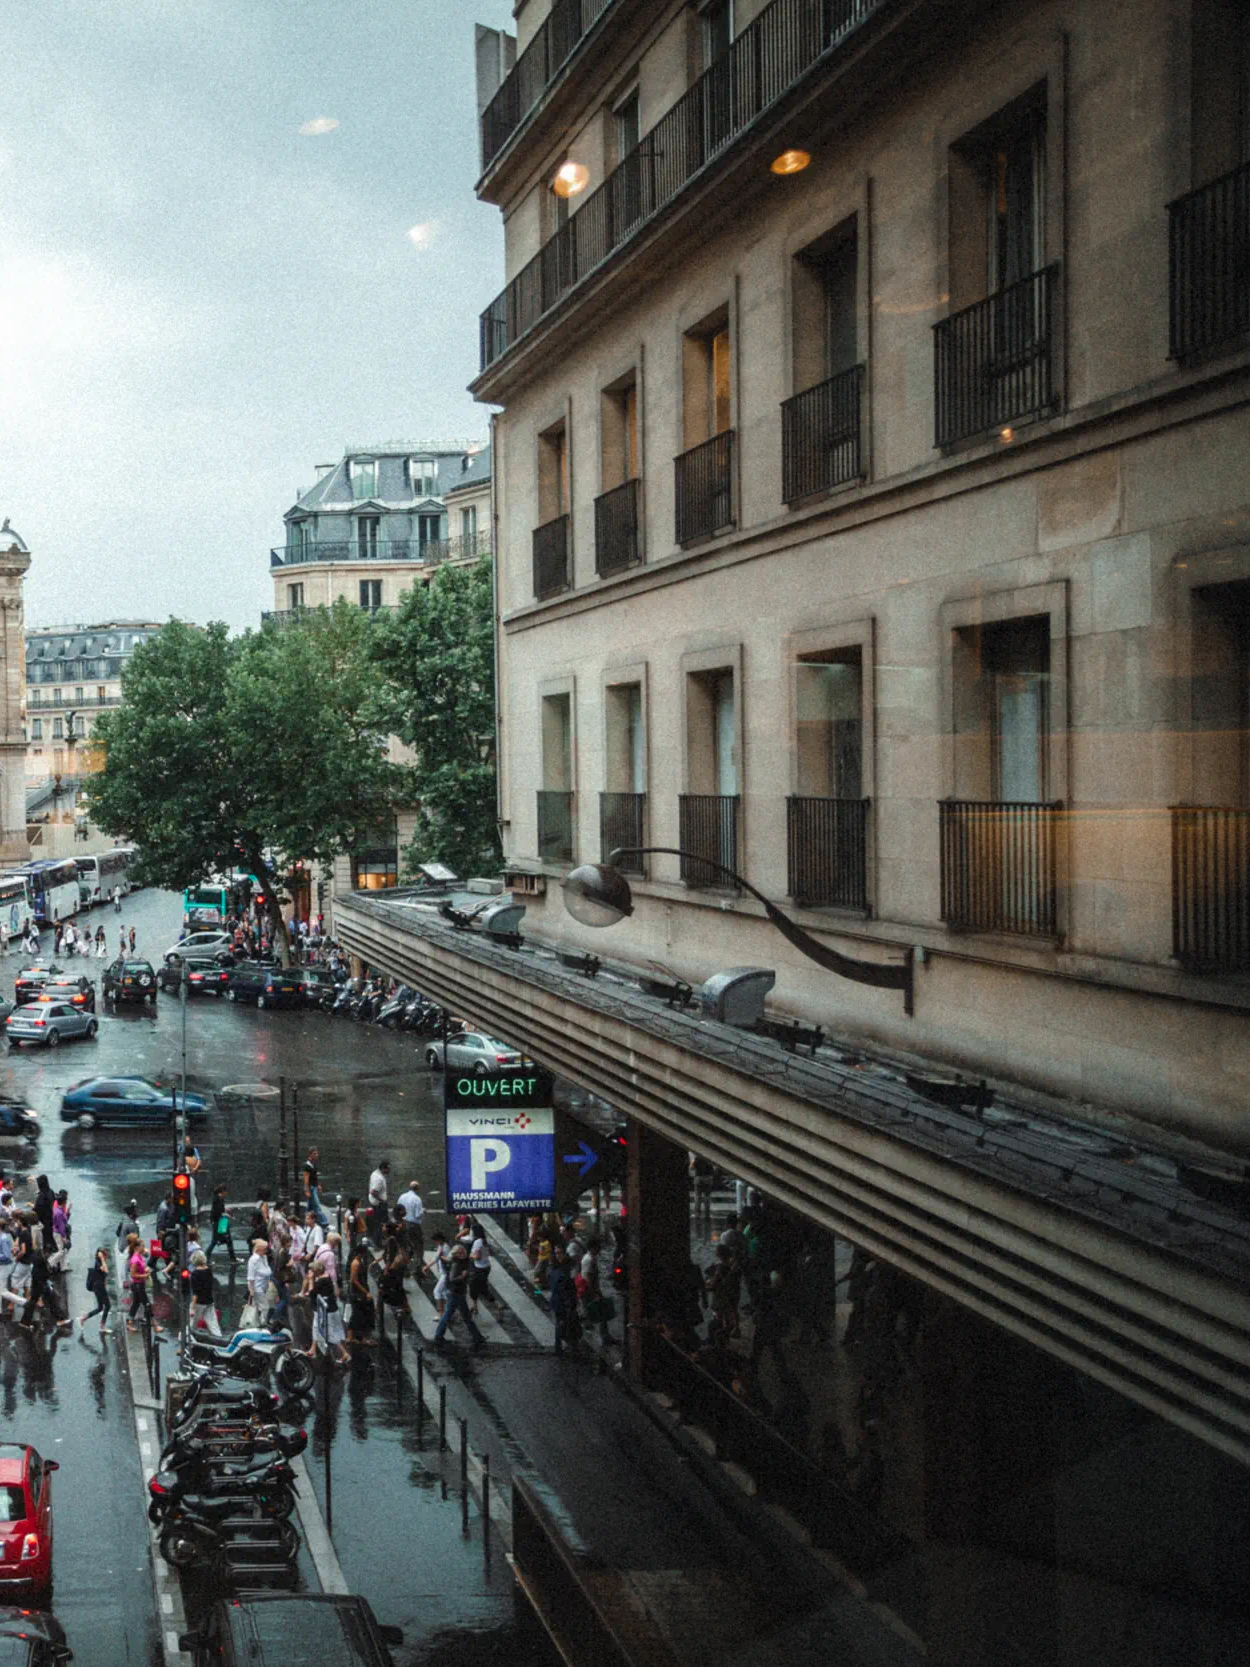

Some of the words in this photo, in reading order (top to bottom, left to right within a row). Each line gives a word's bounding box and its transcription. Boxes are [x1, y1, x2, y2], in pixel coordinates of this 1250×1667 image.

[457, 1079, 536, 1096] OUVERT
[470, 1138, 511, 1190] P
[453, 1191, 515, 1200] HAUSSMANN
[453, 1200, 498, 1210] GALERIES
[500, 1199, 551, 1208] LAFAYETTE
